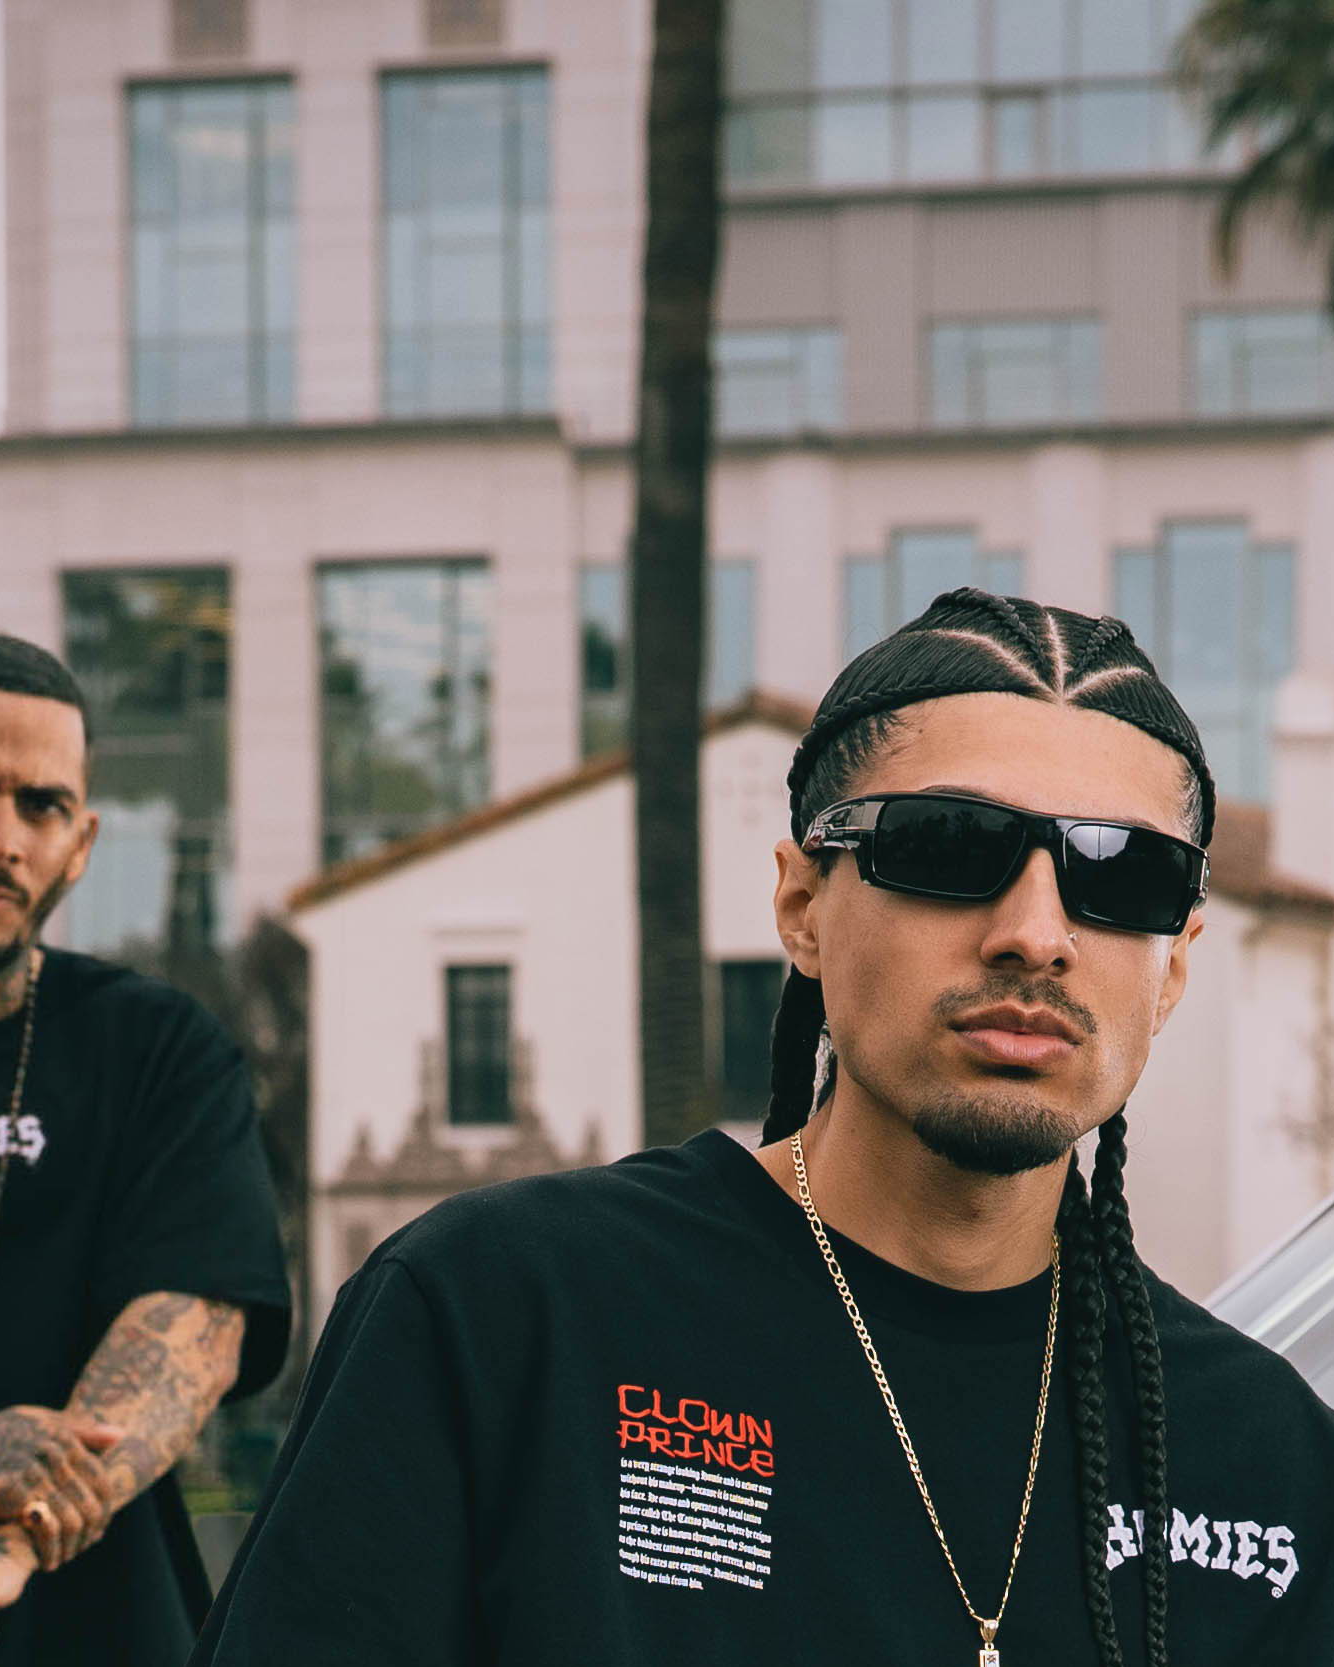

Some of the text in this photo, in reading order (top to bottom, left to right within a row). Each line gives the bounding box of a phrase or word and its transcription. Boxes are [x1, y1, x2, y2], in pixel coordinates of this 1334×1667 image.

[617, 1384, 773, 1448] CLOWN
[616, 1420, 775, 1477] PRINCE
[1106, 1504, 1299, 1593] HMIES
